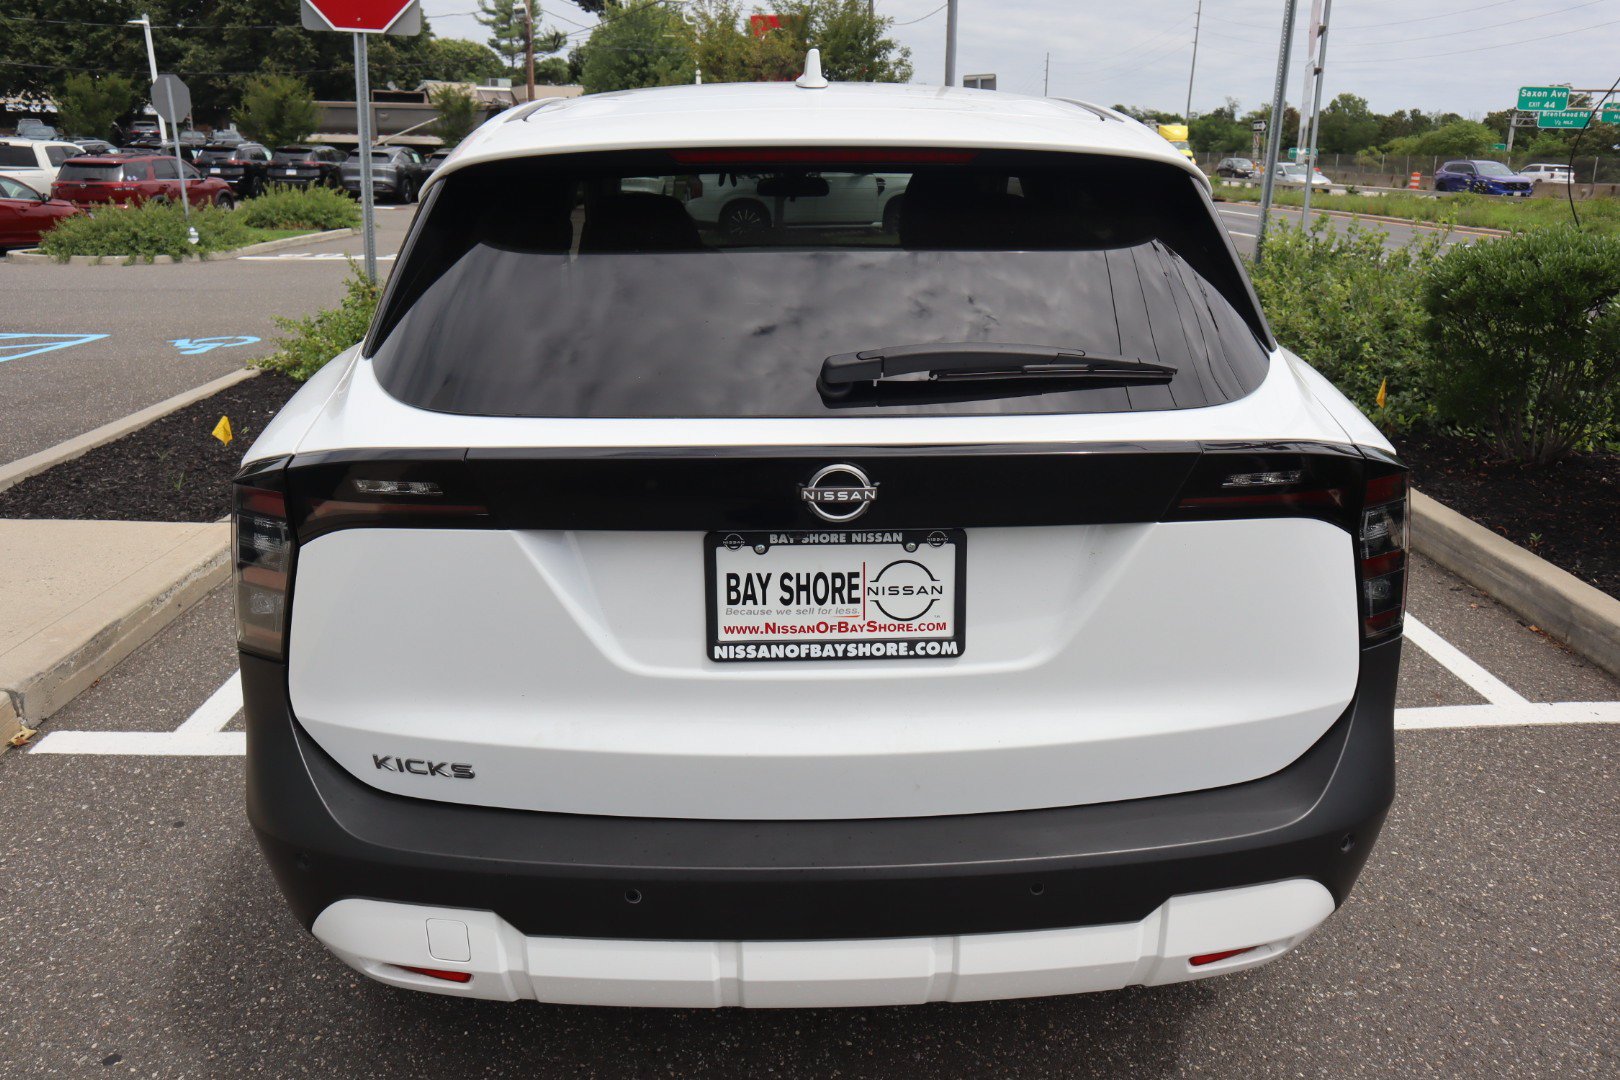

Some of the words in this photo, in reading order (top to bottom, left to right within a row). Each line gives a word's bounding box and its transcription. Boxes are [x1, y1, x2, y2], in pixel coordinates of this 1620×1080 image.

[1521, 89, 1548, 98] Saxon
[1550, 89, 1567, 98] Ave
[1543, 101, 1556, 109] 44
[803, 490, 876, 501] NISSAN
[851, 532, 903, 543] NISSAN
[725, 572, 773, 606] BAY
[779, 571, 861, 606] SHORE
[867, 585, 943, 596] NISSAN
[725, 607, 773, 616] Because
[795, 607, 815, 615] sell
[817, 607, 832, 615] for
[835, 606, 860, 615] less.
[713, 641, 958, 660] NISSANOFBAYSHORE.COM
[372, 753, 476, 780] KICKS
